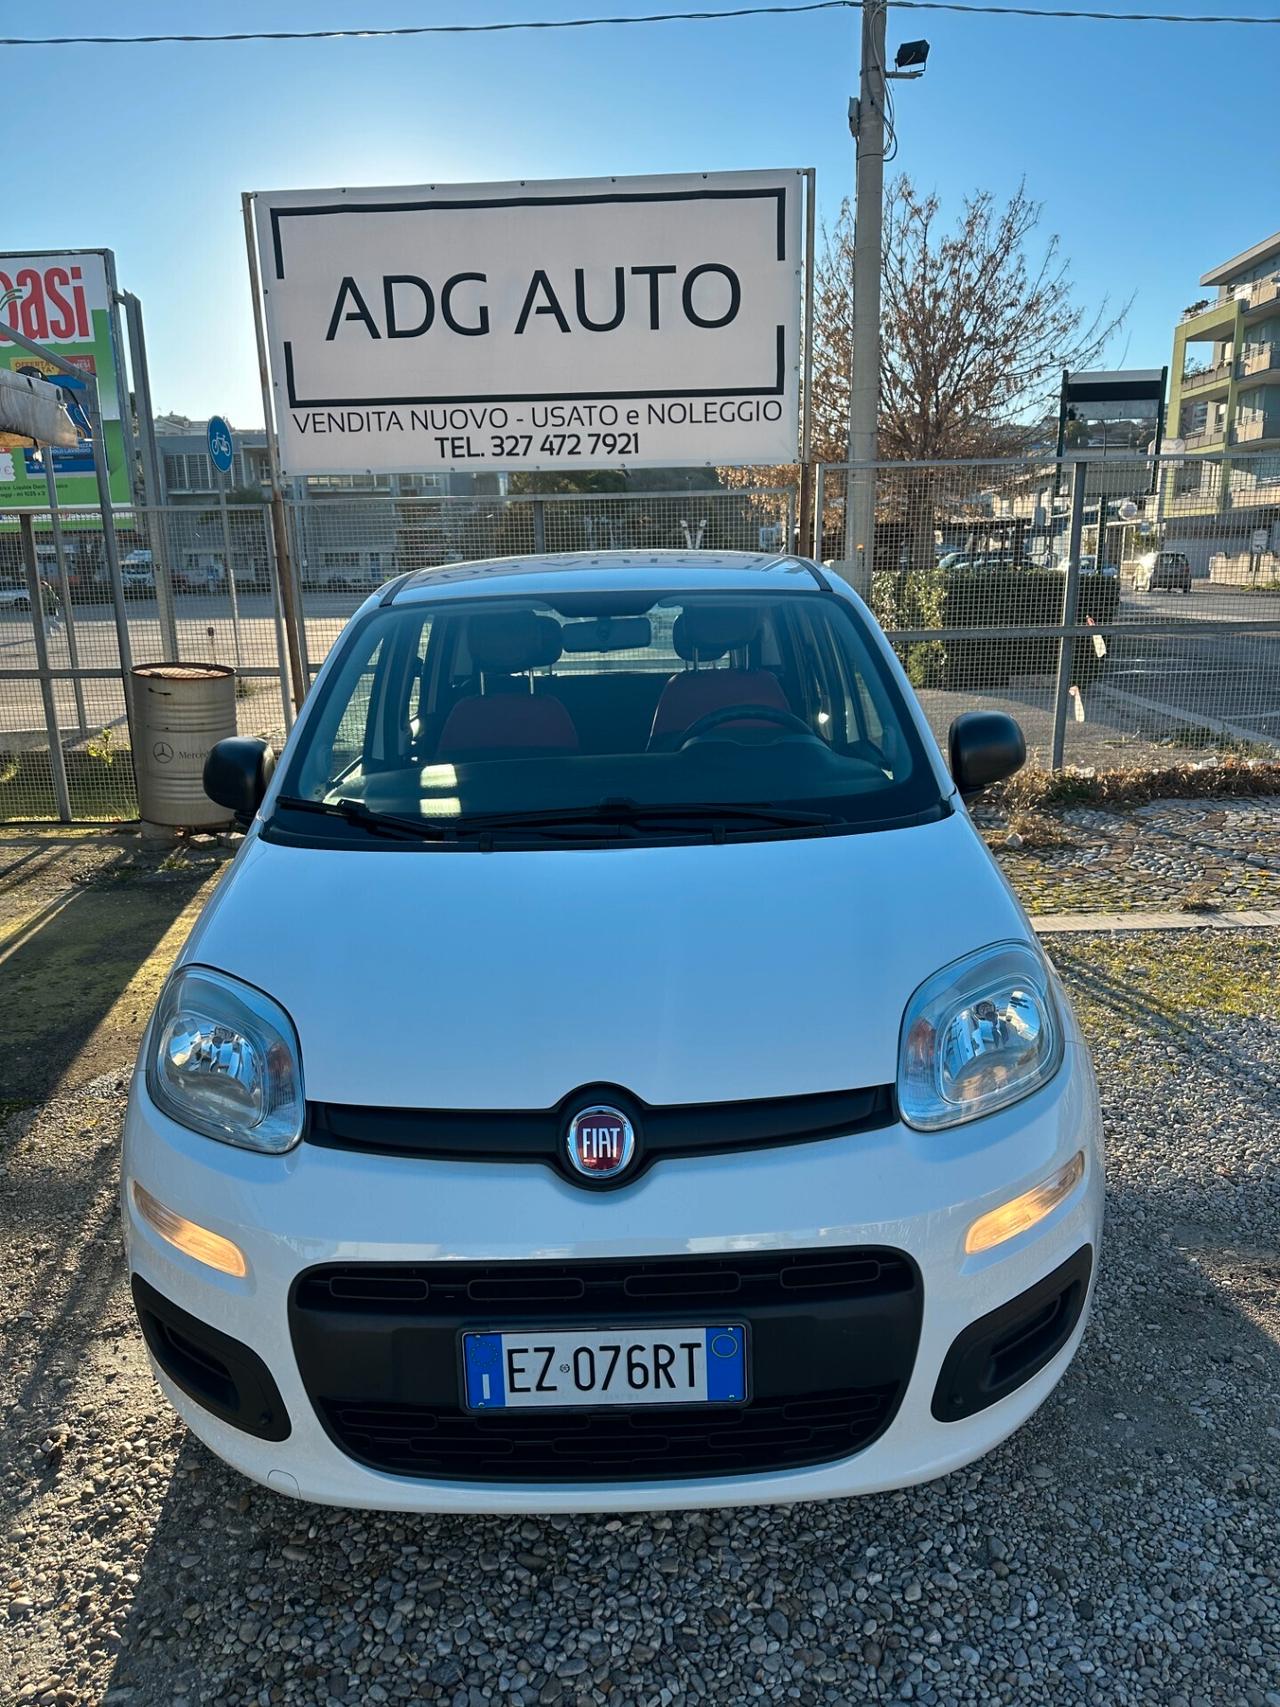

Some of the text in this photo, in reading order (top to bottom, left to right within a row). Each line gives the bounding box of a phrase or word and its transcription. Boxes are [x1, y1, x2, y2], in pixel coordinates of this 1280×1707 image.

[325, 262, 742, 342] ADG AUTO
[292, 410, 404, 435] VENDITA
[410, 406, 509, 431] NUOVO
[530, 404, 620, 428] USATO
[626, 409, 640, 426] e
[647, 400, 784, 424] NOLEGGIO
[434, 432, 639, 459] TEL. 327 472 7921
[582, 1127, 621, 1158] FIAT
[507, 1342, 702, 1393] EZ 076RT
